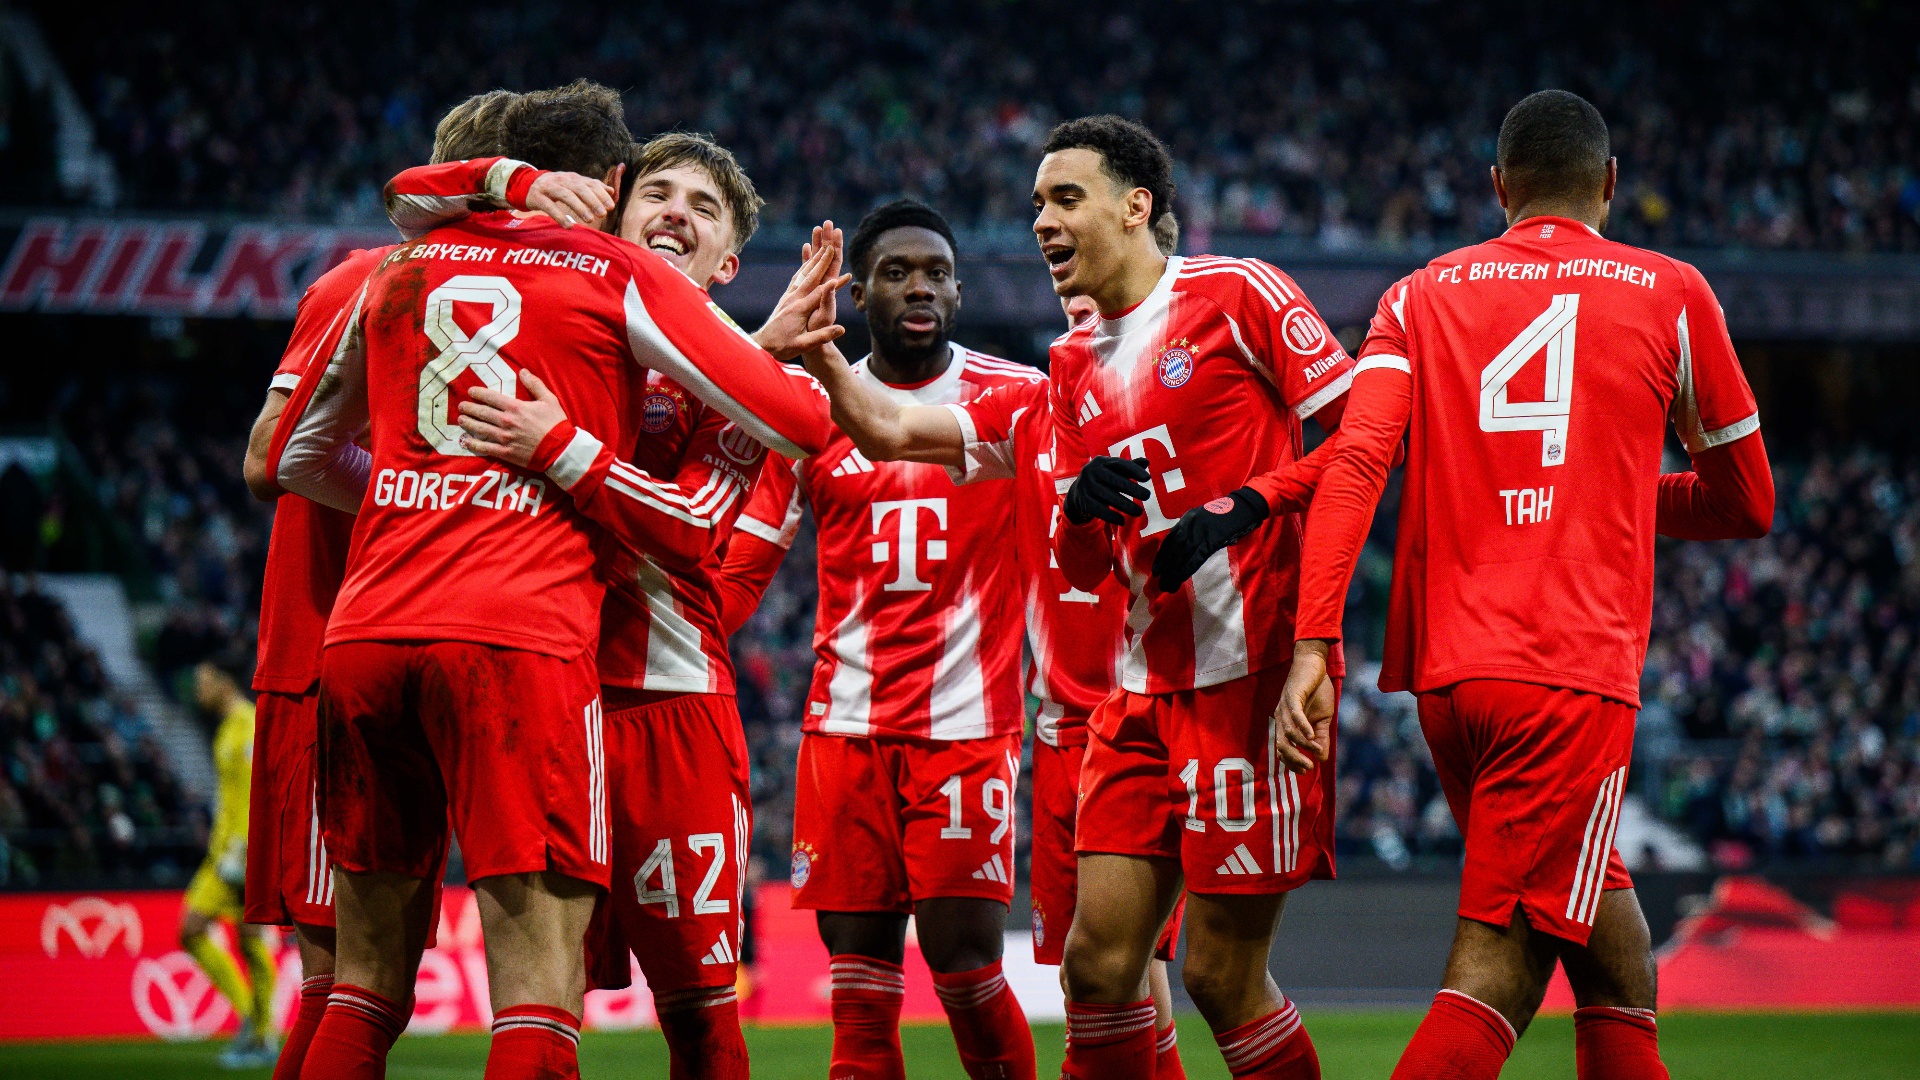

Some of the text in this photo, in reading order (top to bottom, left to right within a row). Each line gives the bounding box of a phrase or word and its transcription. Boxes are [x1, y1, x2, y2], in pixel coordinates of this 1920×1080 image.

[382, 243, 610, 277] FC BAYERN MÜNCHEN
[1437, 258, 1656, 289] FC BAYERN MÜNCHEN
[417, 274, 523, 457] 8
[1167, 351, 1188, 362] BAYERN
[1302, 349, 1346, 384] Allianz
[1478, 293, 1581, 467] 4
[651, 397, 674, 415] BAYERN
[374, 468, 546, 517] GORETZKA
[702, 453, 751, 493] Allianz
[1499, 485, 1555, 526] TAH
[871, 498, 948, 592] T
[939, 774, 1010, 845] 19
[1178, 757, 1257, 833] 10
[633, 832, 730, 918] 42
